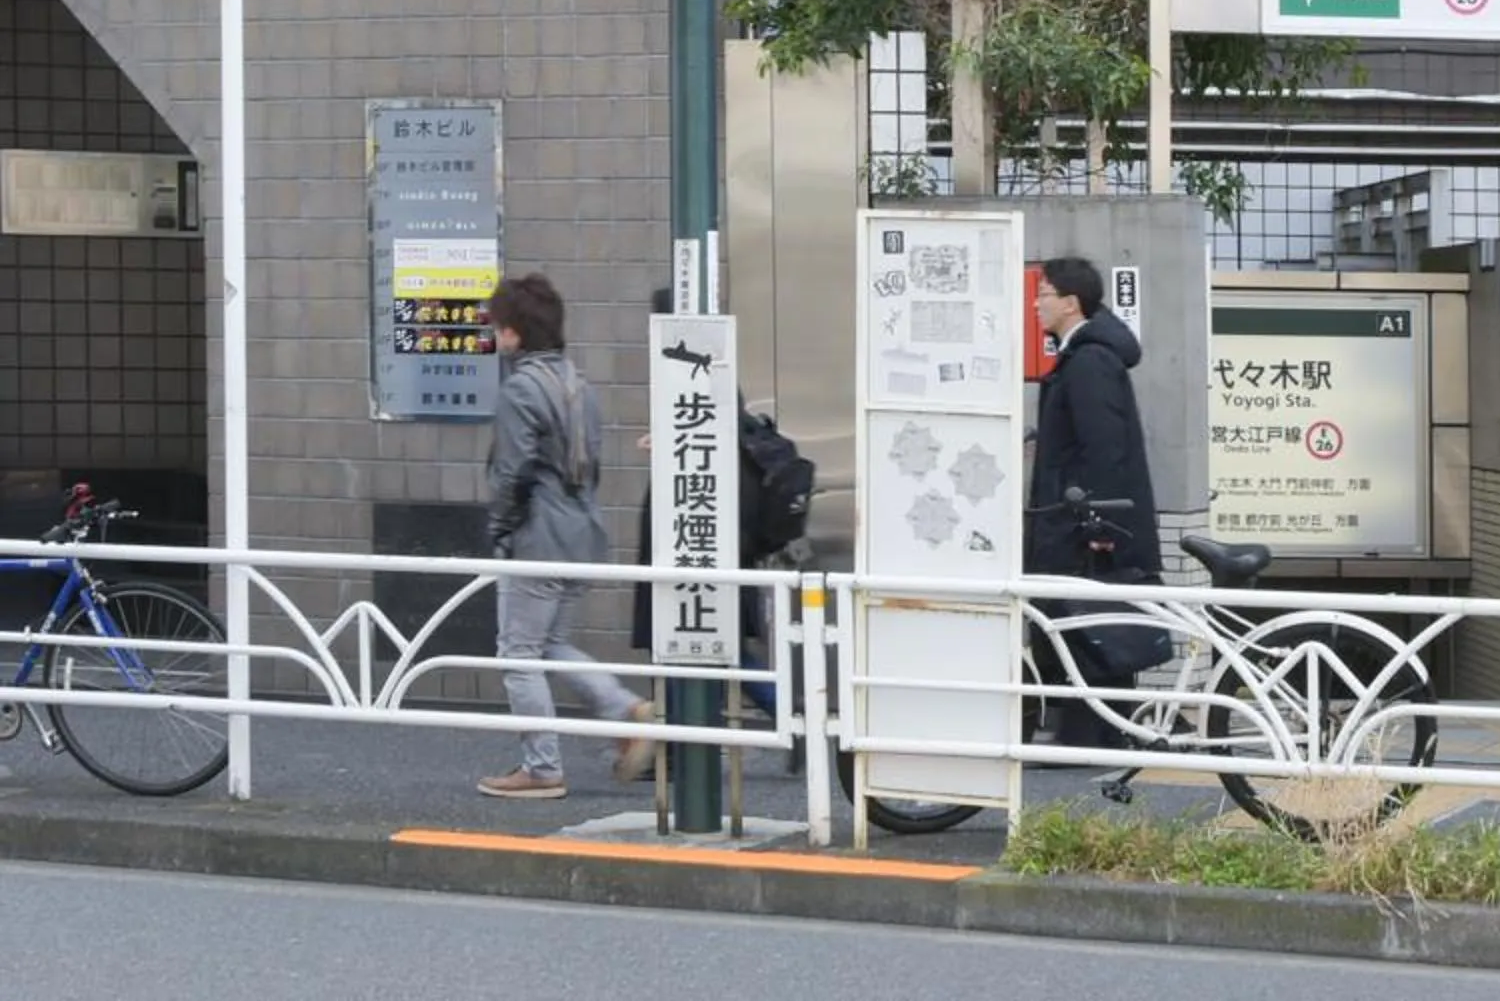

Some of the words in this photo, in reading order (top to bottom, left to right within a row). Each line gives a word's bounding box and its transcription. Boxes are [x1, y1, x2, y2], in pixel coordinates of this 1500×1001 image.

[393, 119, 476, 137] 鈴木ビル
[1380, 315, 1403, 332] A1
[1213, 359, 1332, 390] 代々木駅
[1222, 394, 1280, 410] Yoyogi
[673, 392, 718, 634] 歩行喫煙禁止
